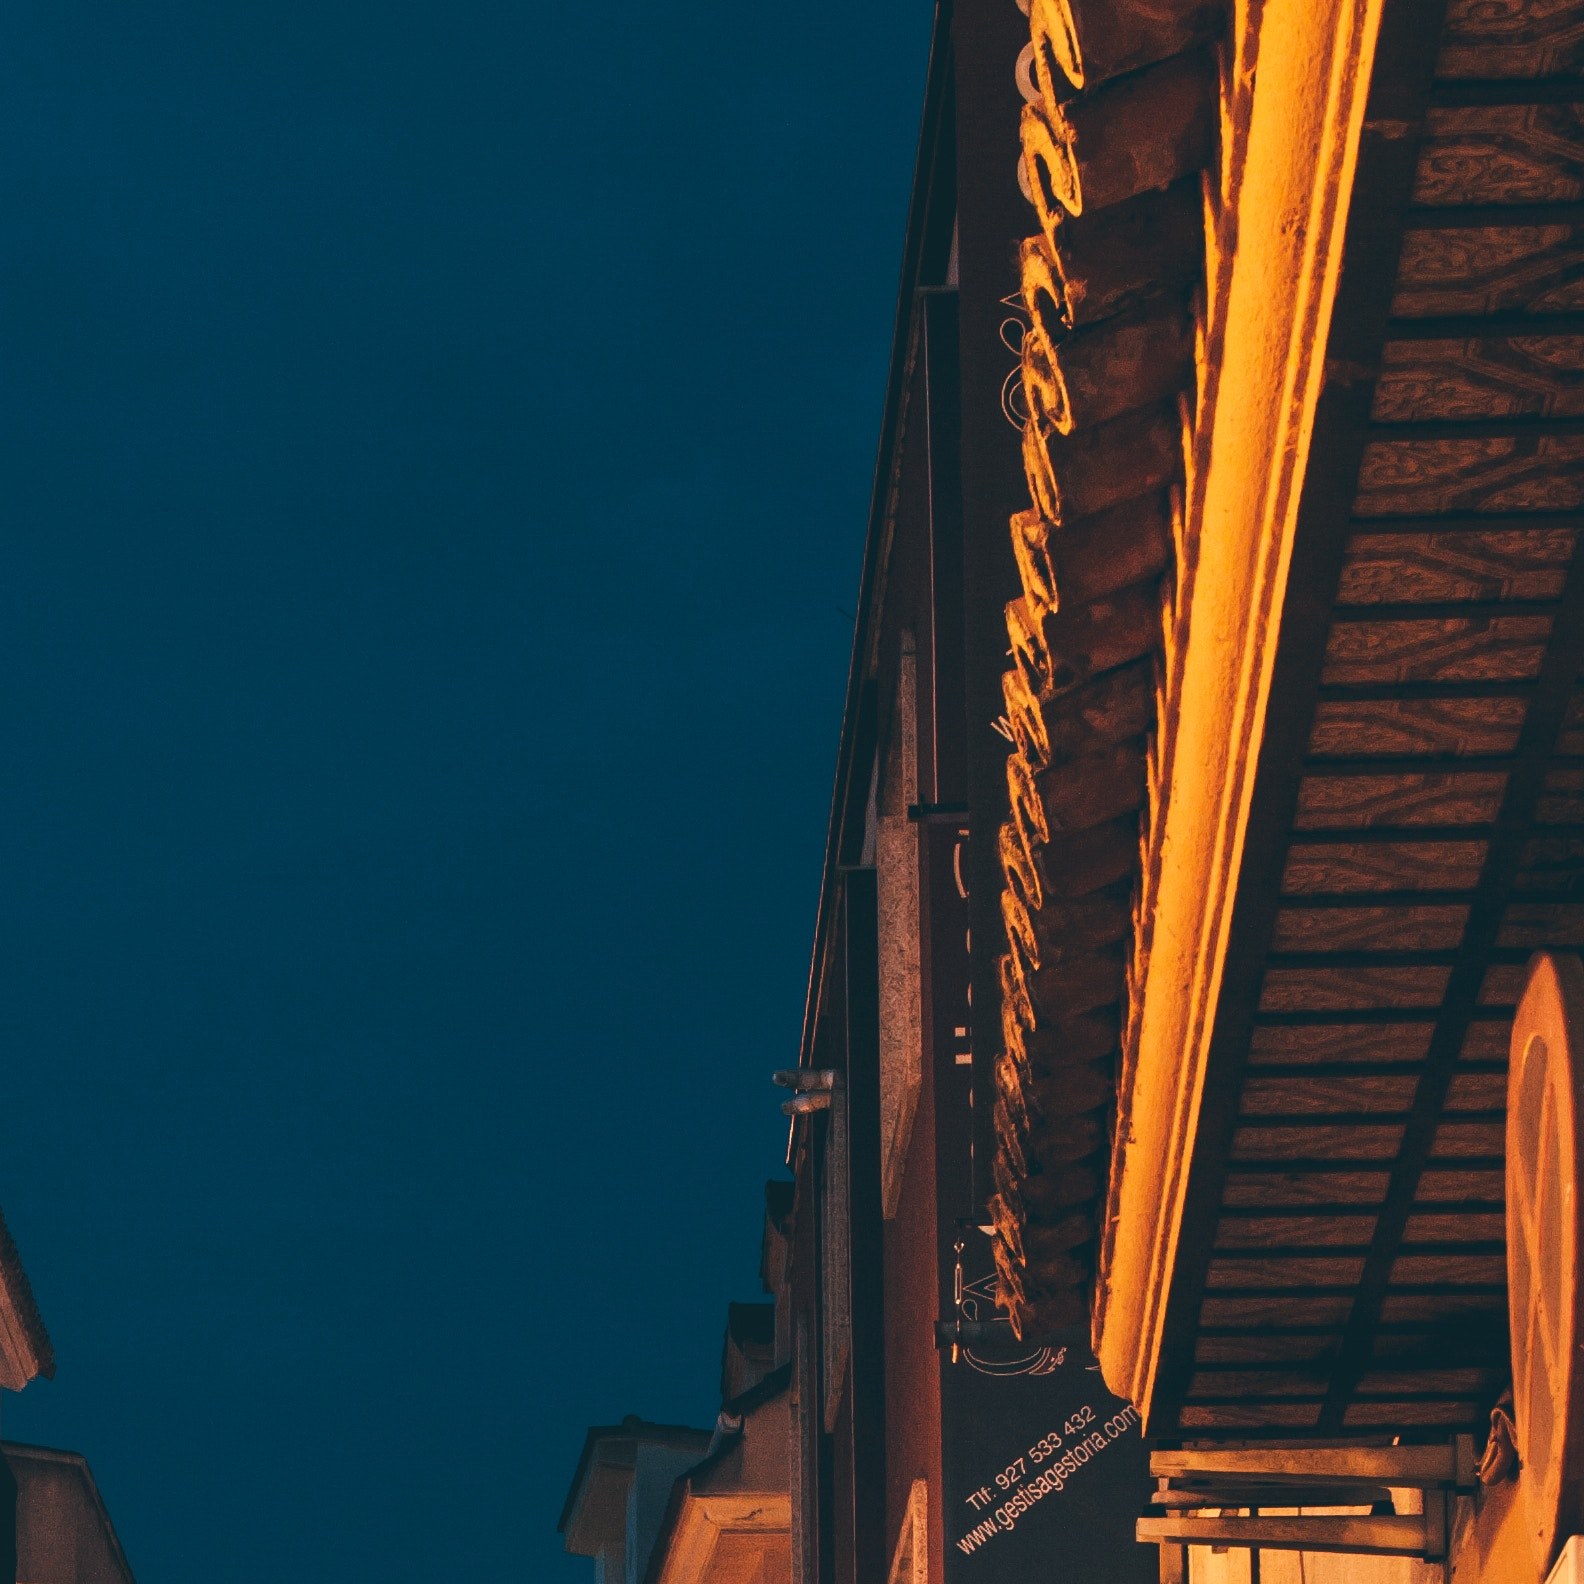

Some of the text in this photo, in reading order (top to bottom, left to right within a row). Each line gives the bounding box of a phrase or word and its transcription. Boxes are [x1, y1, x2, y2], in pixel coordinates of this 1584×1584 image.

[955, 1404, 1141, 1555] www.gestisagestoria.com
[995, 1457, 1027, 1490] 927
[1028, 1432, 1063, 1464] 533
[1064, 1405, 1097, 1436] 432
